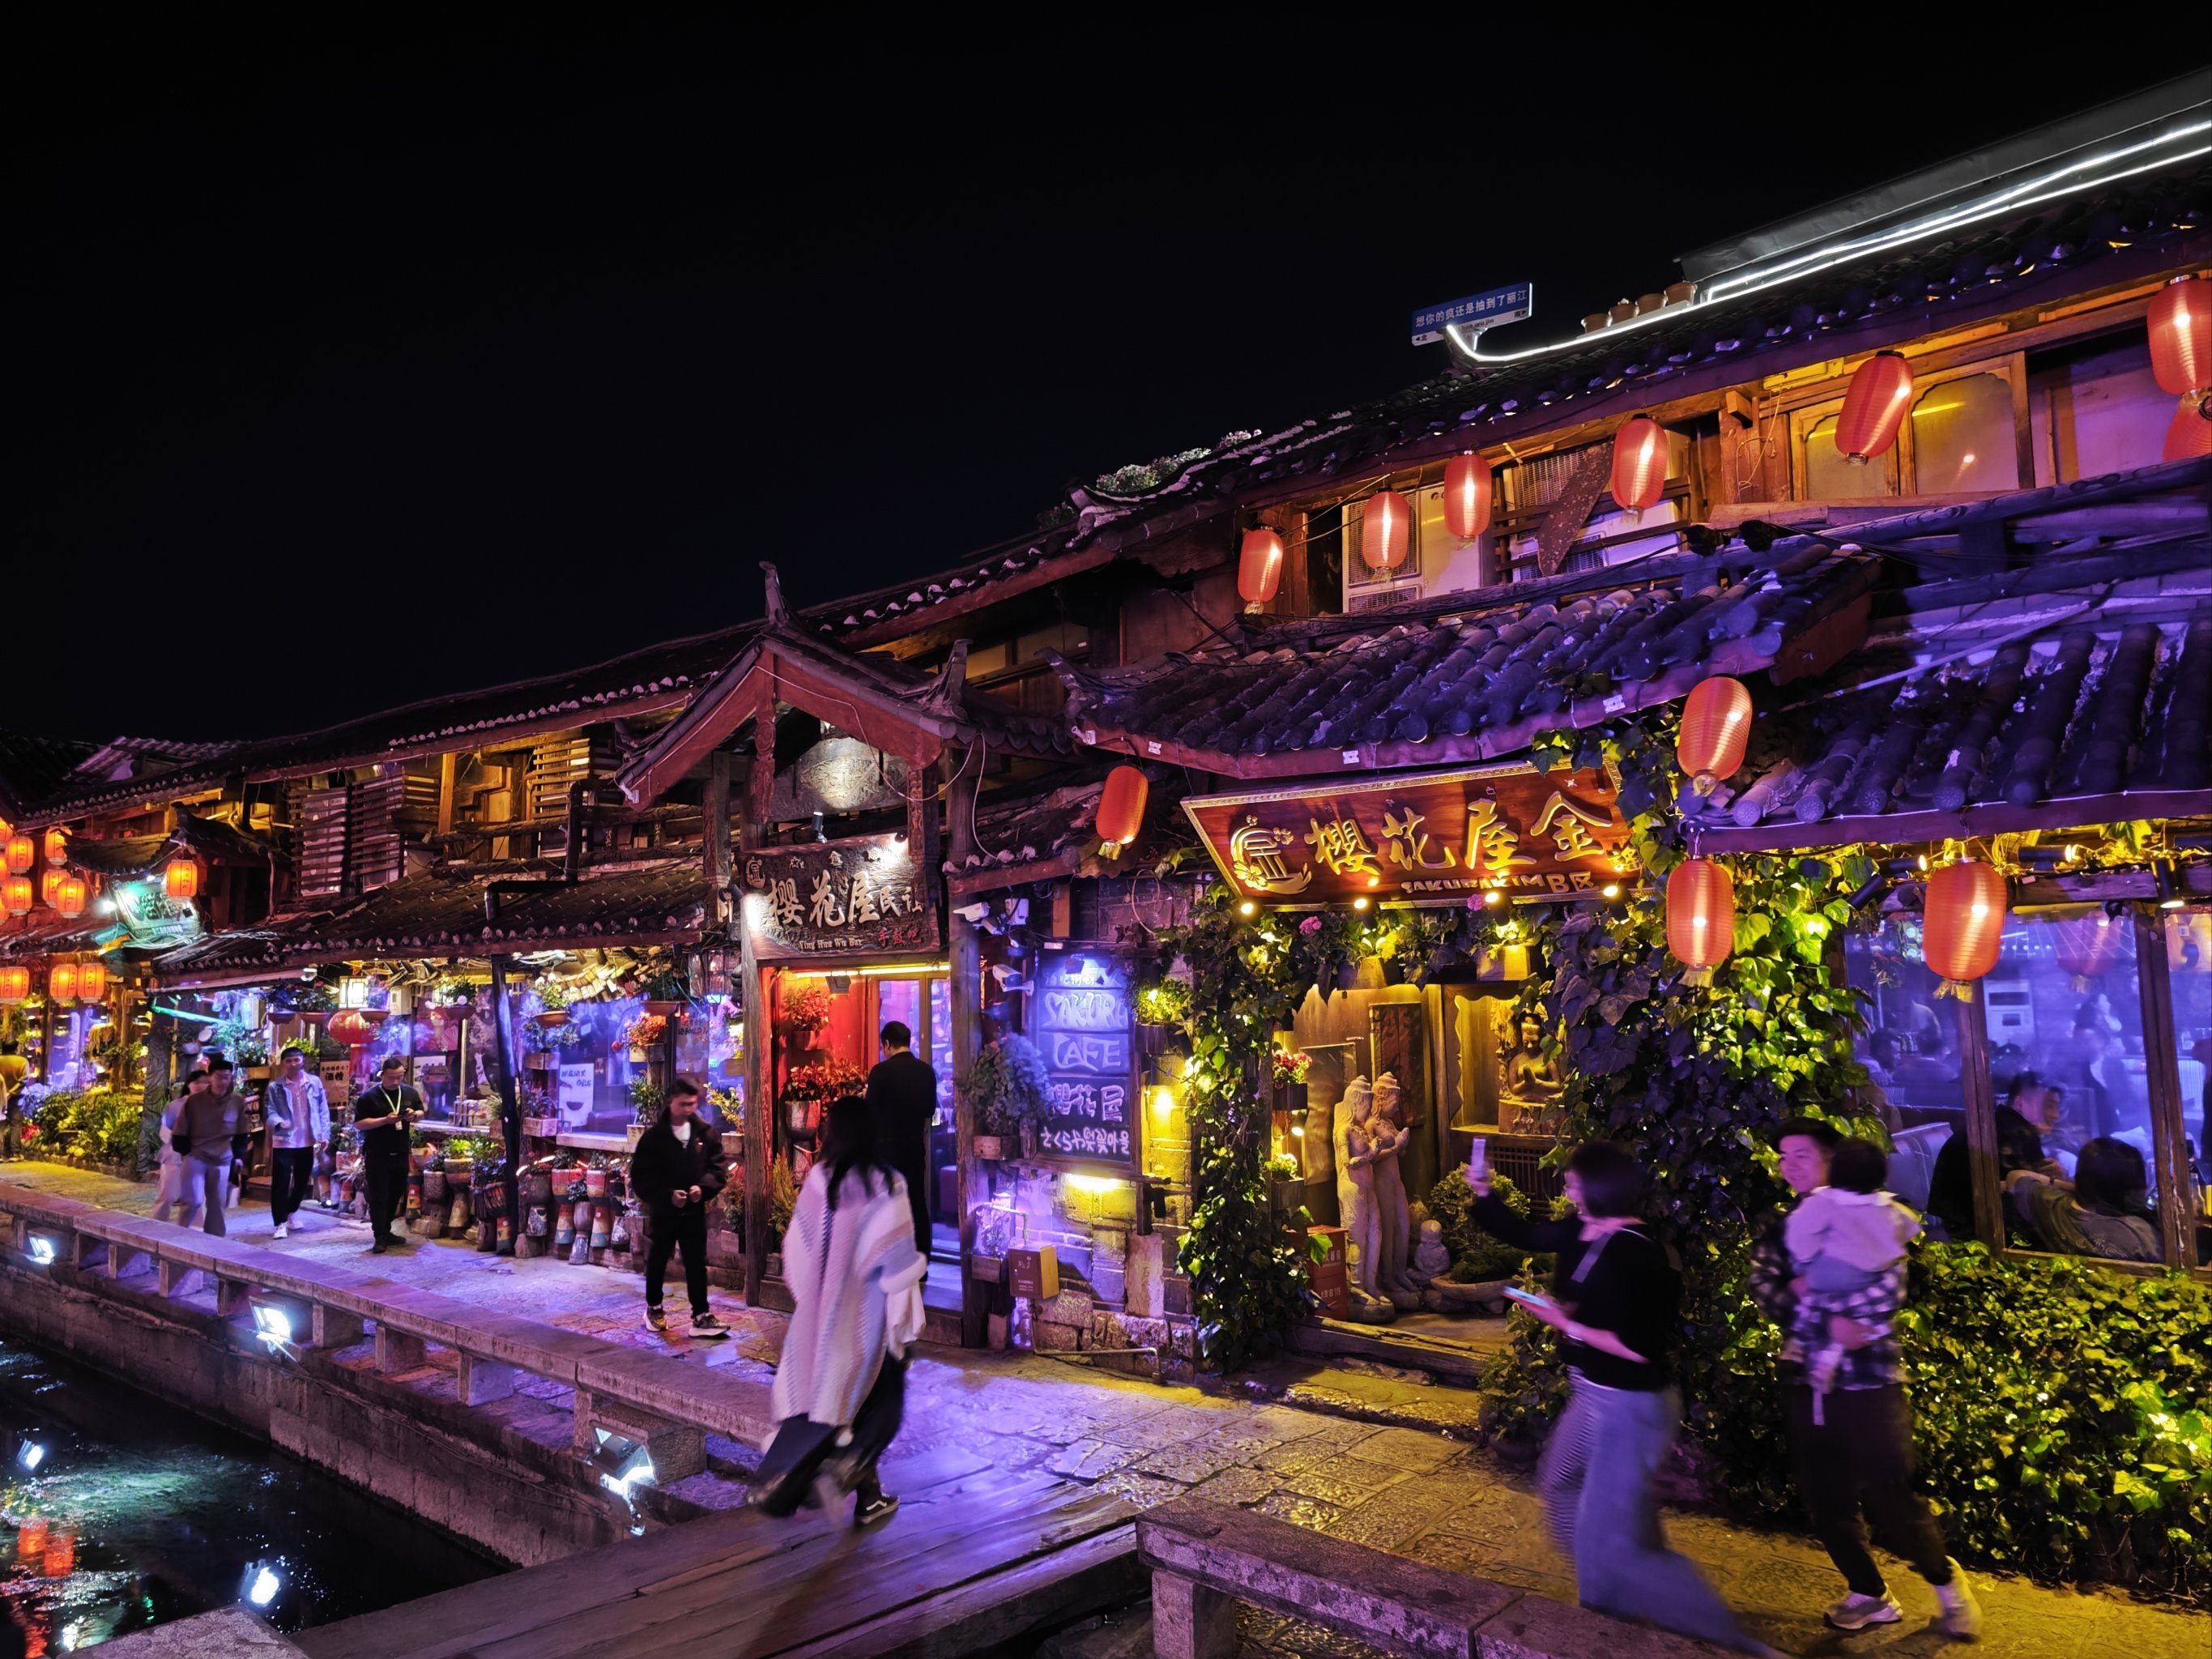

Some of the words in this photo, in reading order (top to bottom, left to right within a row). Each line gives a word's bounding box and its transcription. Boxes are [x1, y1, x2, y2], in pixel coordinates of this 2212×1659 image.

[1415, 289, 1528, 328] 想你的疯还是抽到了丽江
[817, 939, 833, 949] Hua
[833, 938, 847, 947] Wu
[849, 937, 863, 946] Bar
[1042, 992, 1129, 1029] SAKURA
[1054, 1032, 1121, 1072] CAFE
